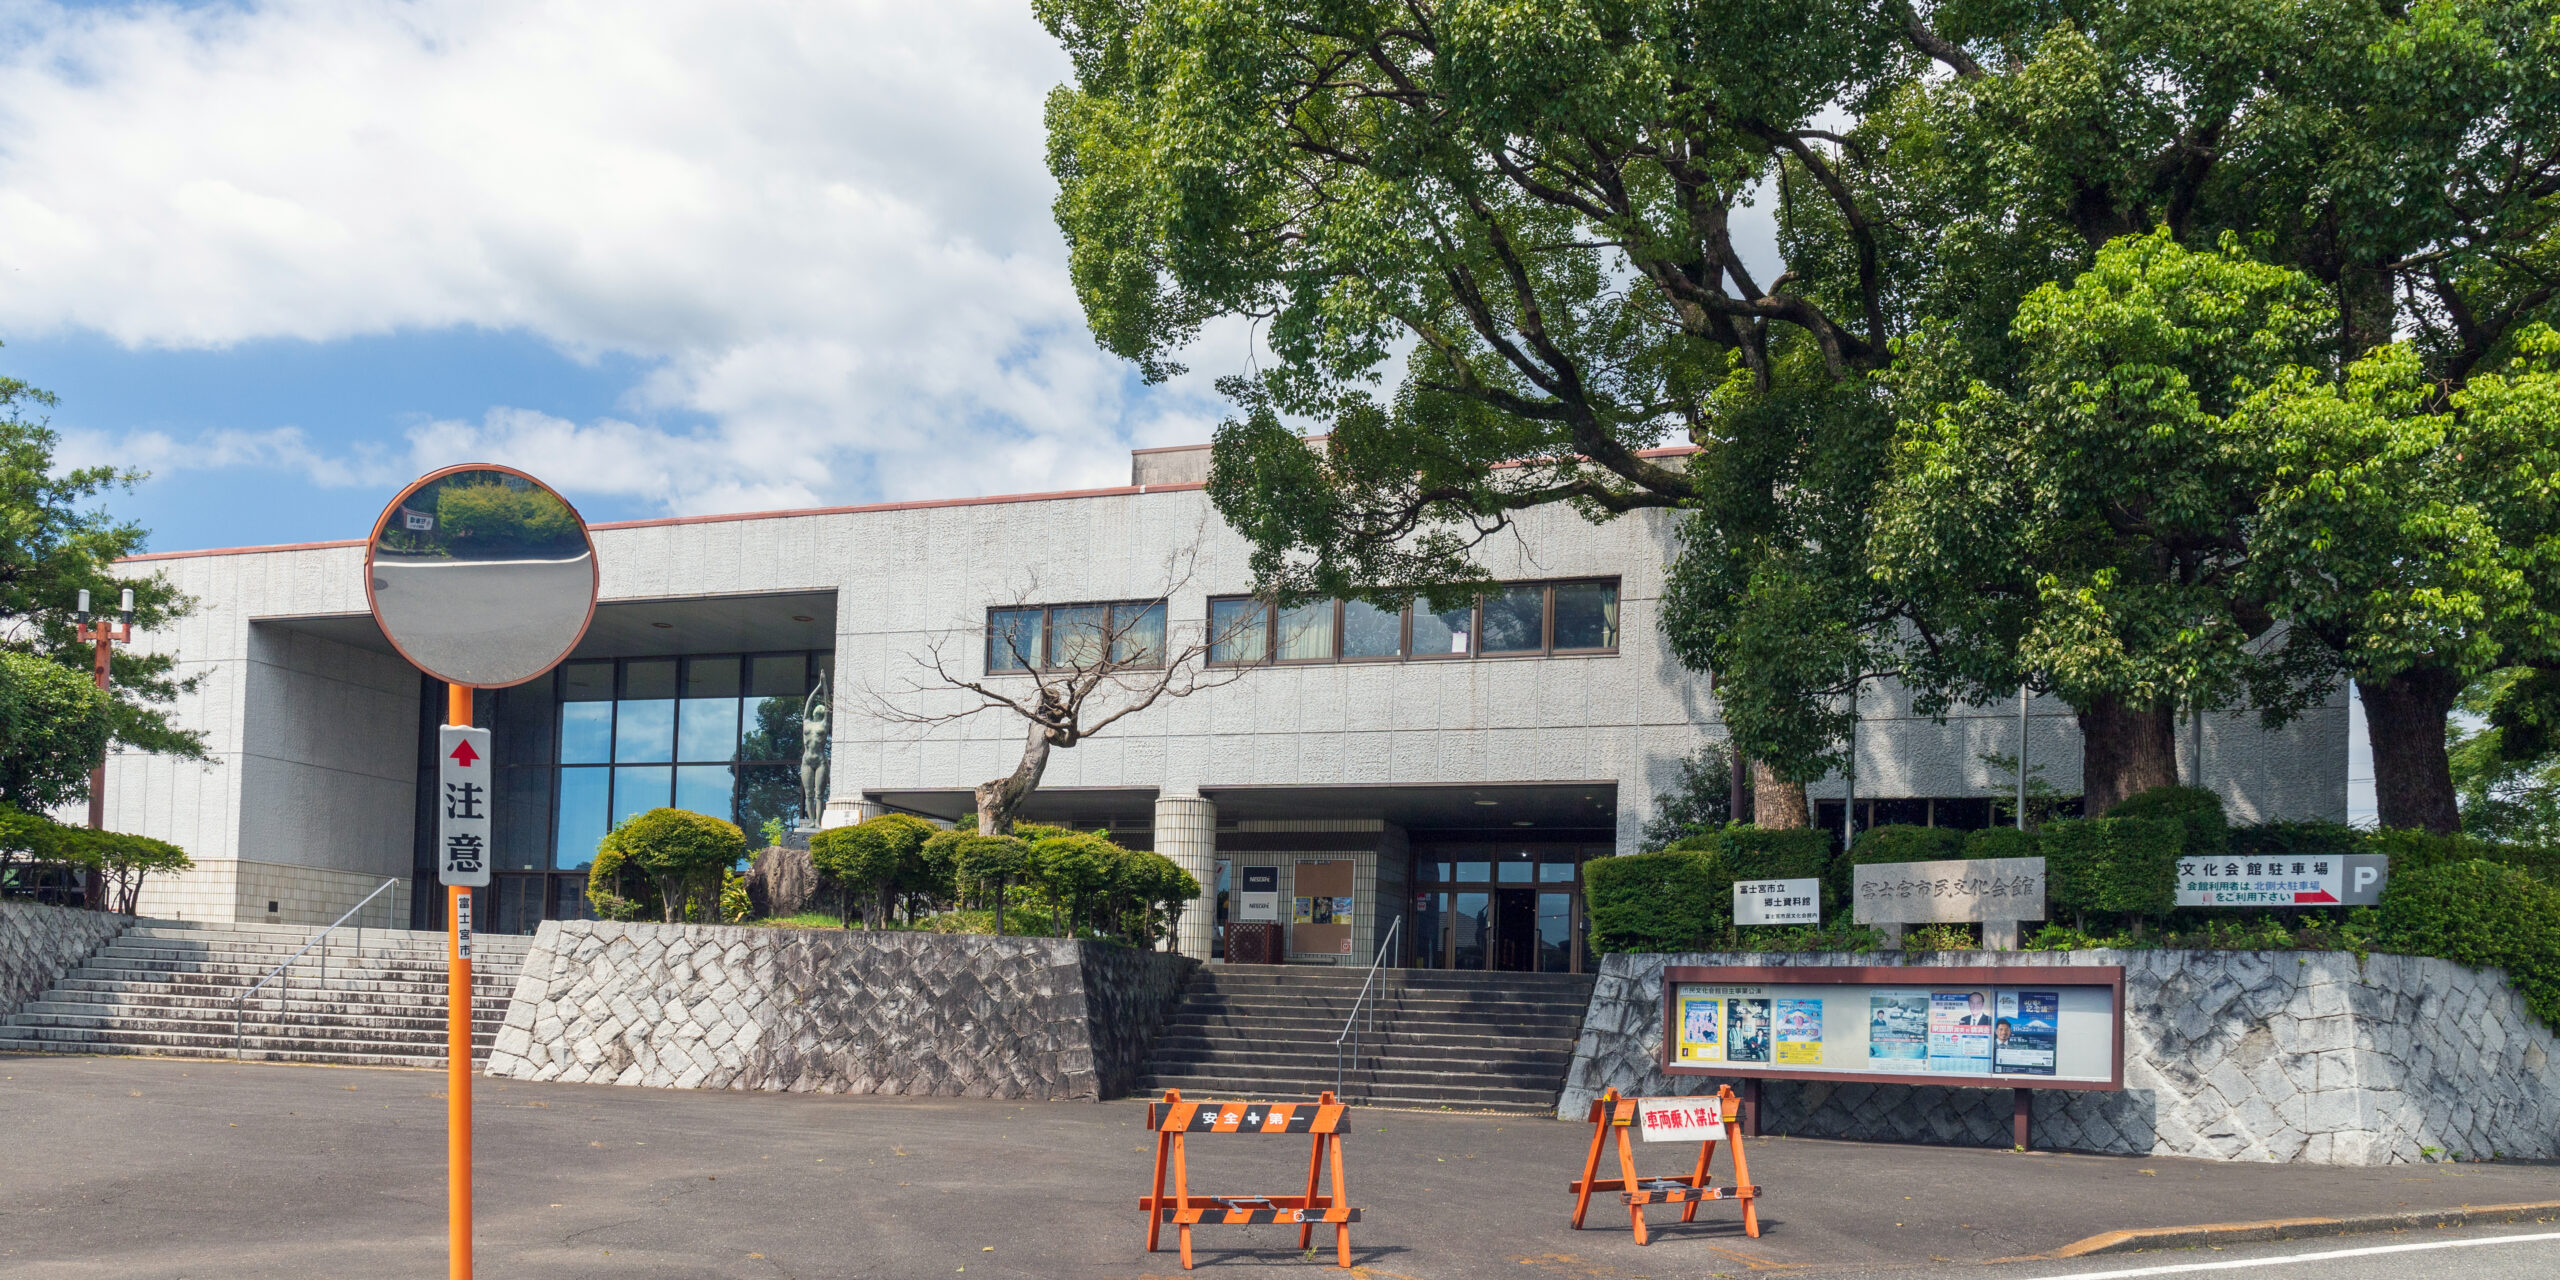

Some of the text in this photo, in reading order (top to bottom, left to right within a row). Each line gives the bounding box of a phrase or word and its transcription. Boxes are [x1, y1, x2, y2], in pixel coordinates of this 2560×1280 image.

[446, 782, 484, 873] 注意
[2181, 862, 2328, 876] 文化会館駐車場
[2254, 881, 2320, 891] 北側大駐車場
[2354, 866, 2378, 893] P
[1740, 884, 1785, 894] 富士宮市立
[1861, 876, 2035, 900] 富士宮市民文化会館
[1764, 897, 1811, 907] 郷土資料館
[2216, 892, 2291, 902] をご利用下さい
[459, 898, 471, 956] 富士宮市
[1202, 1112, 1305, 1124] 安全 第一
[1645, 1107, 1719, 1130] 車両乗入禁止
